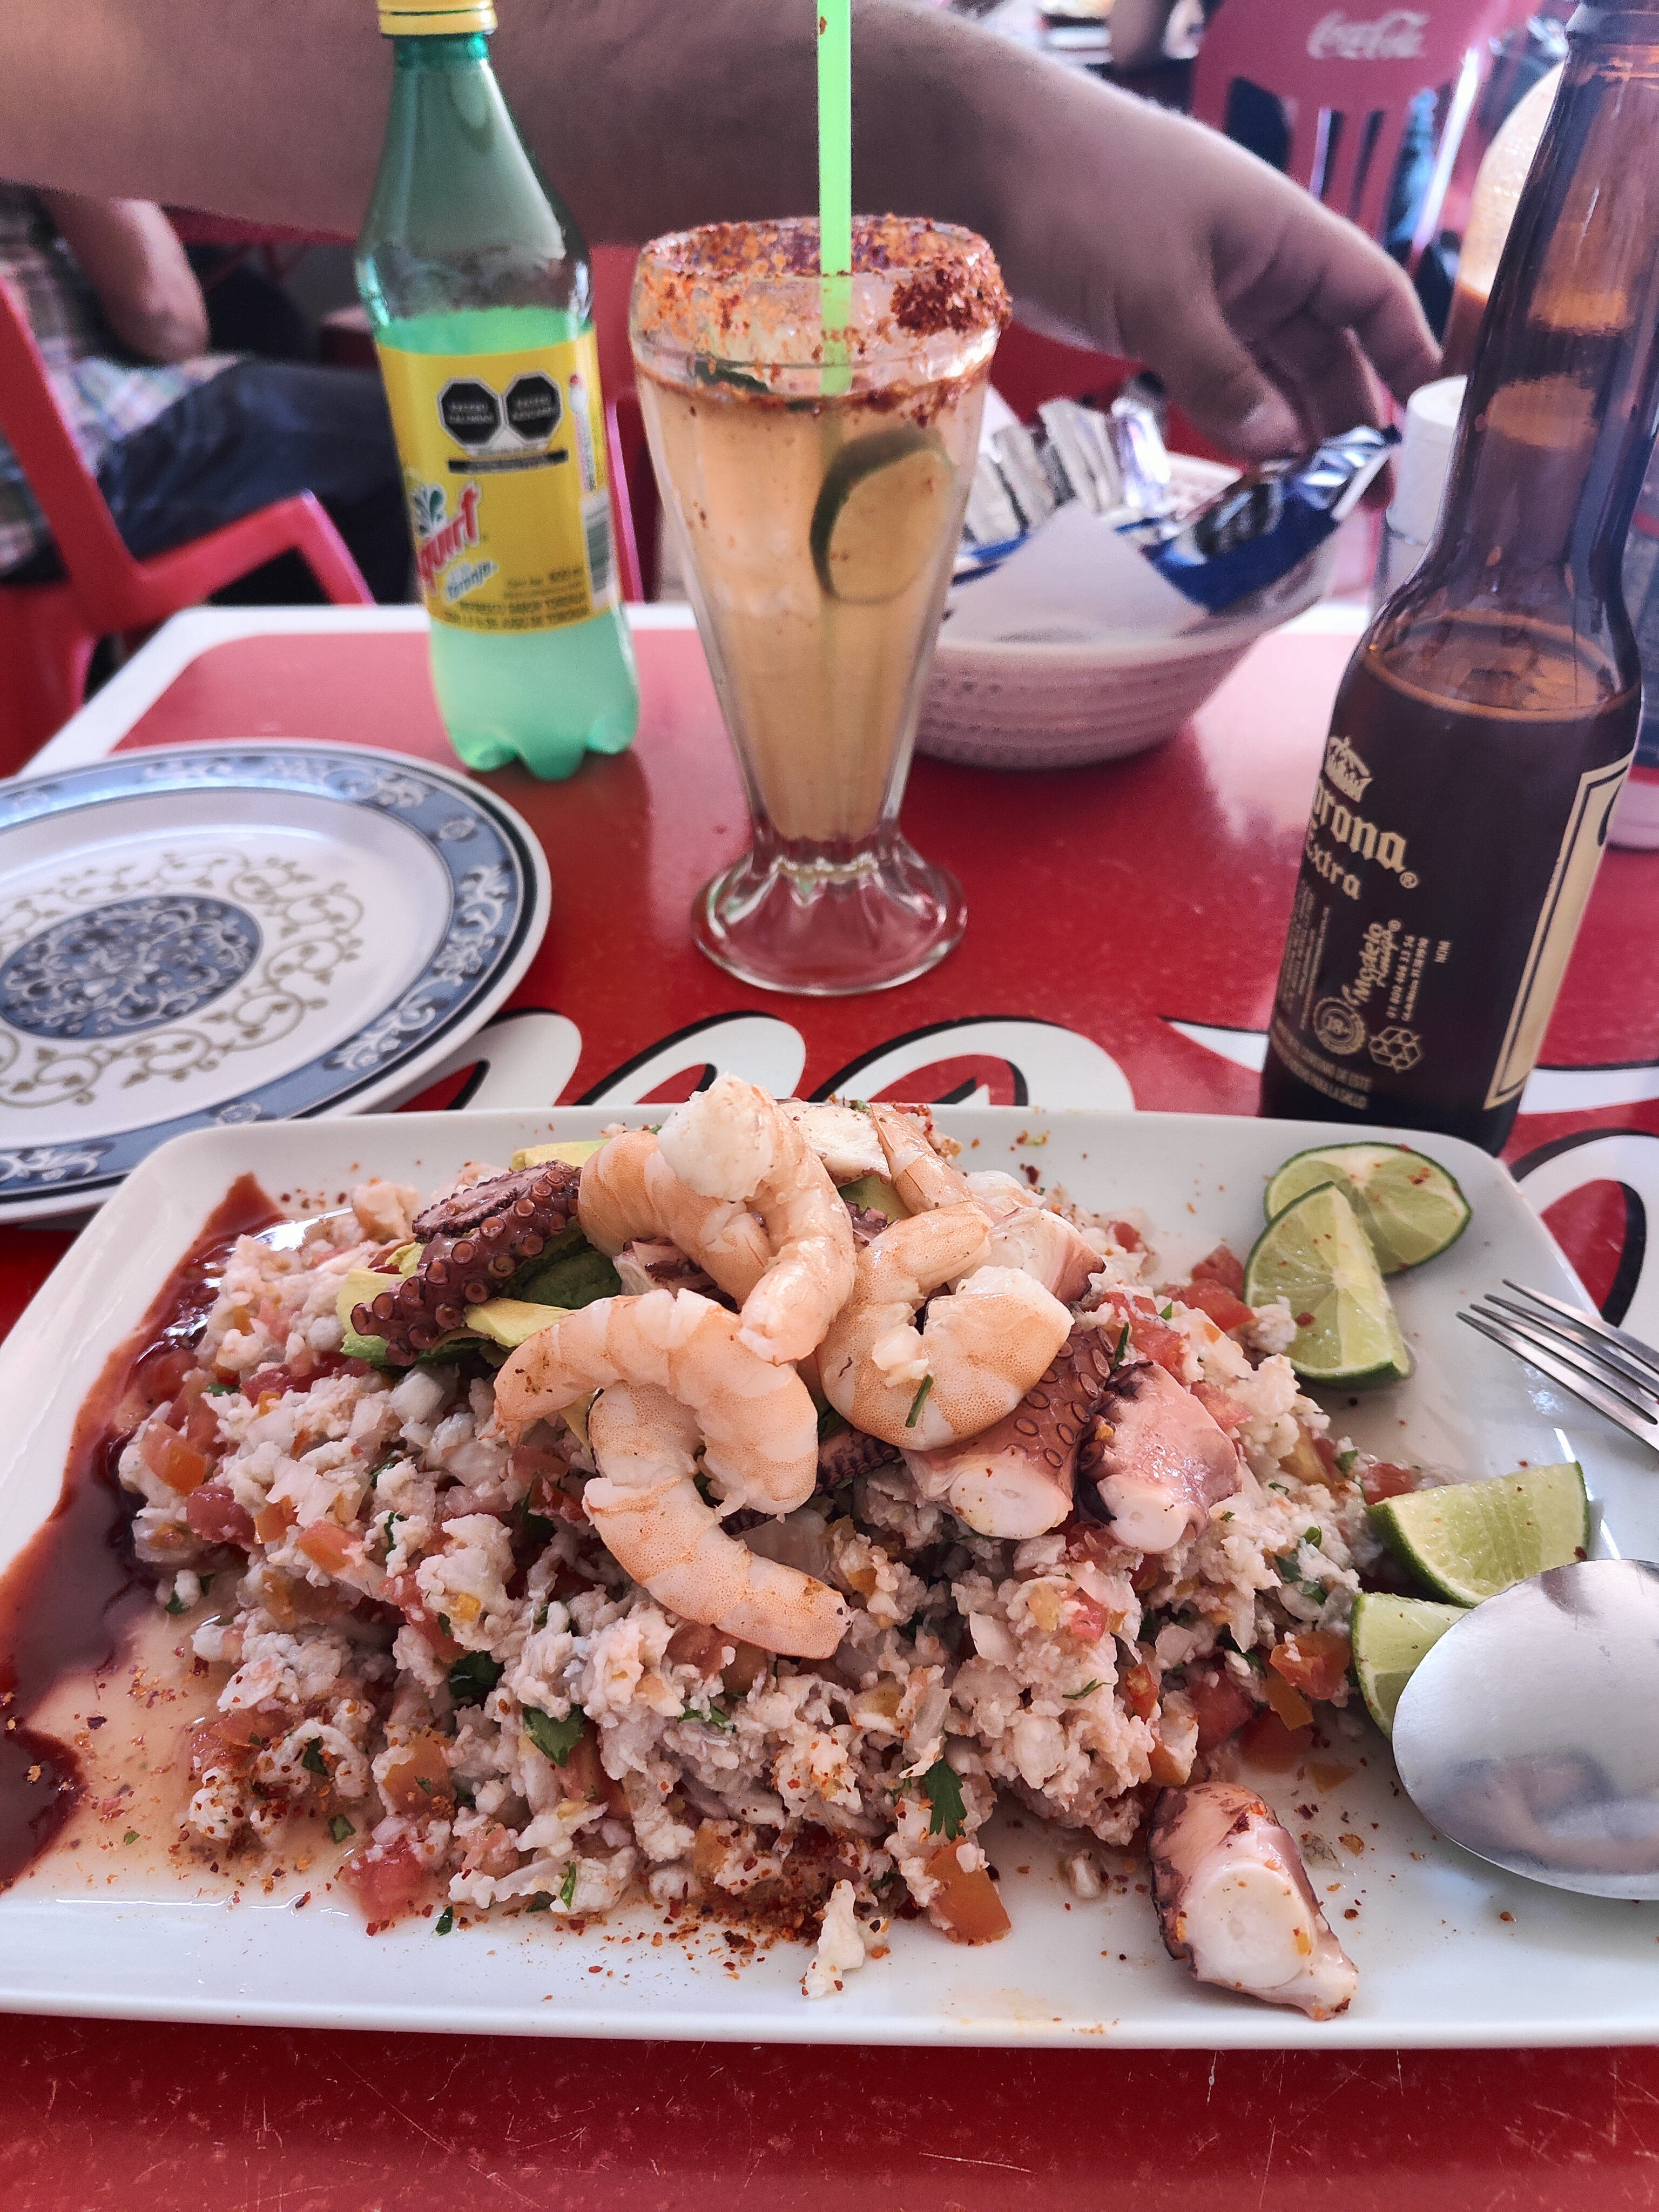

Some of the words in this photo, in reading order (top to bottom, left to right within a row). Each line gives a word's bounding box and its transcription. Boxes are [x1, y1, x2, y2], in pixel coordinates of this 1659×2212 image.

[418, 485, 478, 596] quirt
[1312, 778, 1407, 874] orona
[1341, 922, 1382, 1007] Modelo
[1433, 940, 1453, 964] NOM
